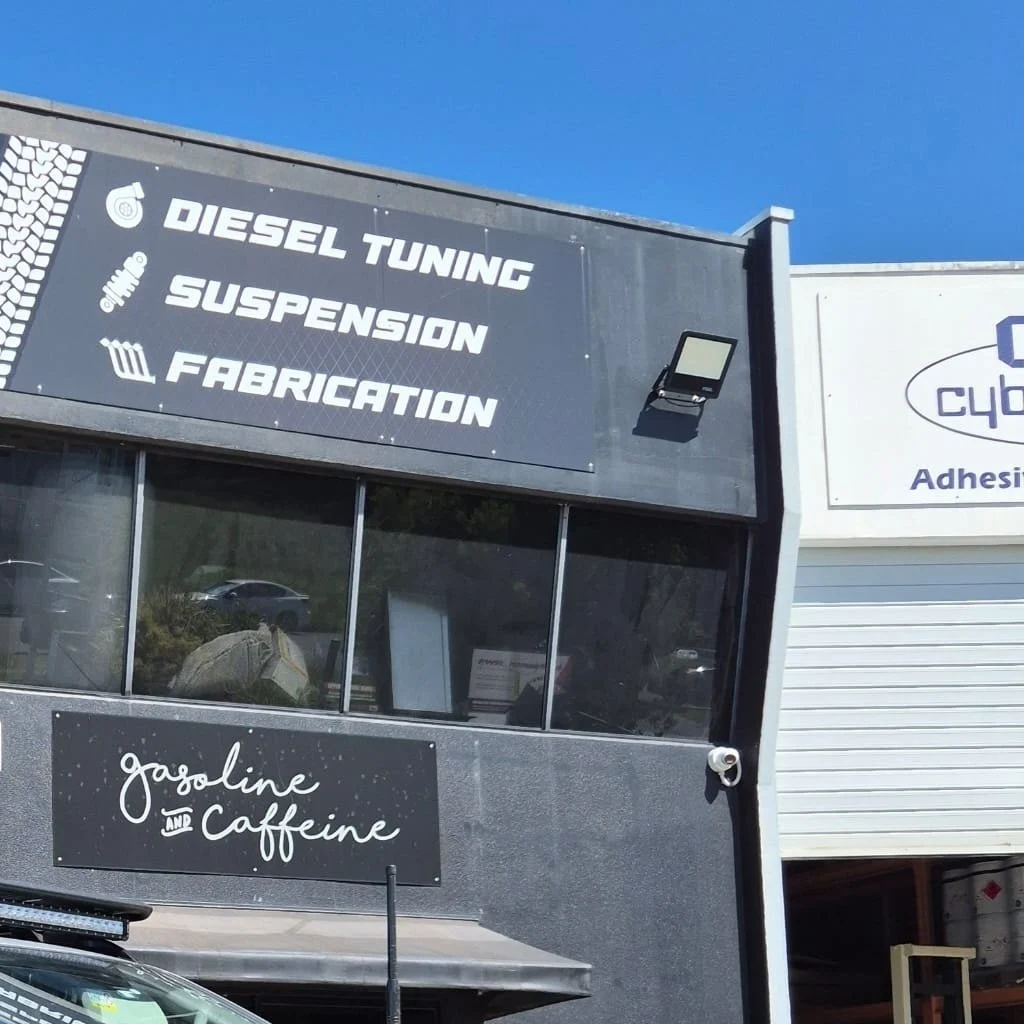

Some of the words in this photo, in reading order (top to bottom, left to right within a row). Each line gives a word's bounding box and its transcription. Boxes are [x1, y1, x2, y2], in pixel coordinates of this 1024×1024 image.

[163, 197, 347, 260] DIESEL
[362, 232, 535, 291] TUNING
[164, 274, 489, 355] SUSPENSION
[165, 351, 499, 428] FABRICATION
[910, 467, 1024, 491] Adhesi
[119, 741, 320, 824] gasoline
